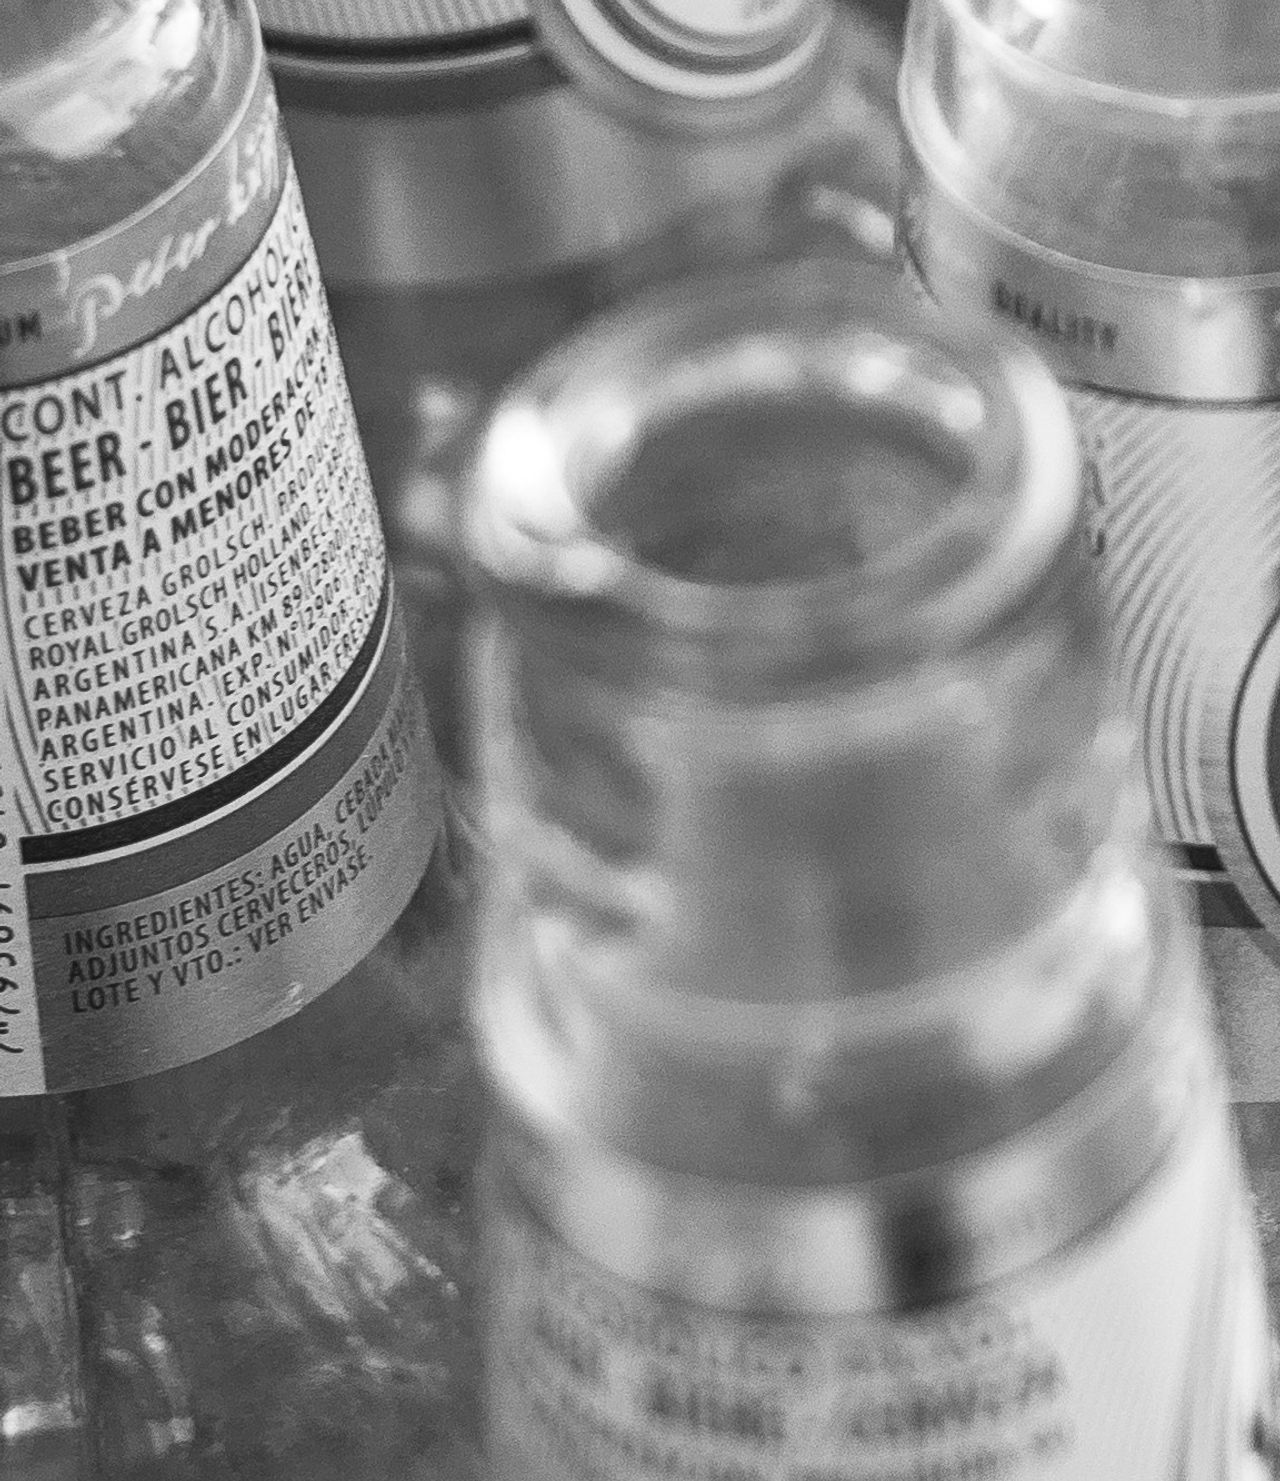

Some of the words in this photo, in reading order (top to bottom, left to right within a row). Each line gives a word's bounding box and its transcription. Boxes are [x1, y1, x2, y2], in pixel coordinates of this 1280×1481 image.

[1, 370, 144, 443] CONT.
[8, 430, 127, 506] BEER
[166, 356, 248, 451] BIER
[12, 501, 127, 555] BEBER
[136, 466, 196, 517] CON
[16, 539, 131, 592] VENTA
[142, 527, 162, 559] A
[171, 428, 292, 546] MENORES
[24, 584, 152, 640] CERVEZA
[29, 630, 114, 670] ROYAL
[121, 576, 228, 646] GROLSCH
[33, 630, 197, 702] ARGENTINA
[36, 637, 242, 732] PANAMERICANA
[247, 608, 278, 648] KM
[282, 583, 303, 619] 89
[40, 690, 215, 762] ARGENTINA.
[43, 736, 177, 794] SERVICIO
[188, 718, 219, 750] AL
[47, 745, 225, 823] CONSÉRVESE
[232, 721, 262, 759] EN
[270, 660, 332, 733] LUGAR
[63, 869, 265, 955] INGREDIENTES:
[68, 922, 210, 985] ADJUNTOS
[70, 975, 142, 1014] LOTE
[147, 970, 165, 997] Y
[248, 914, 295, 955] VER
[297, 844, 374, 925] ENVASE.
